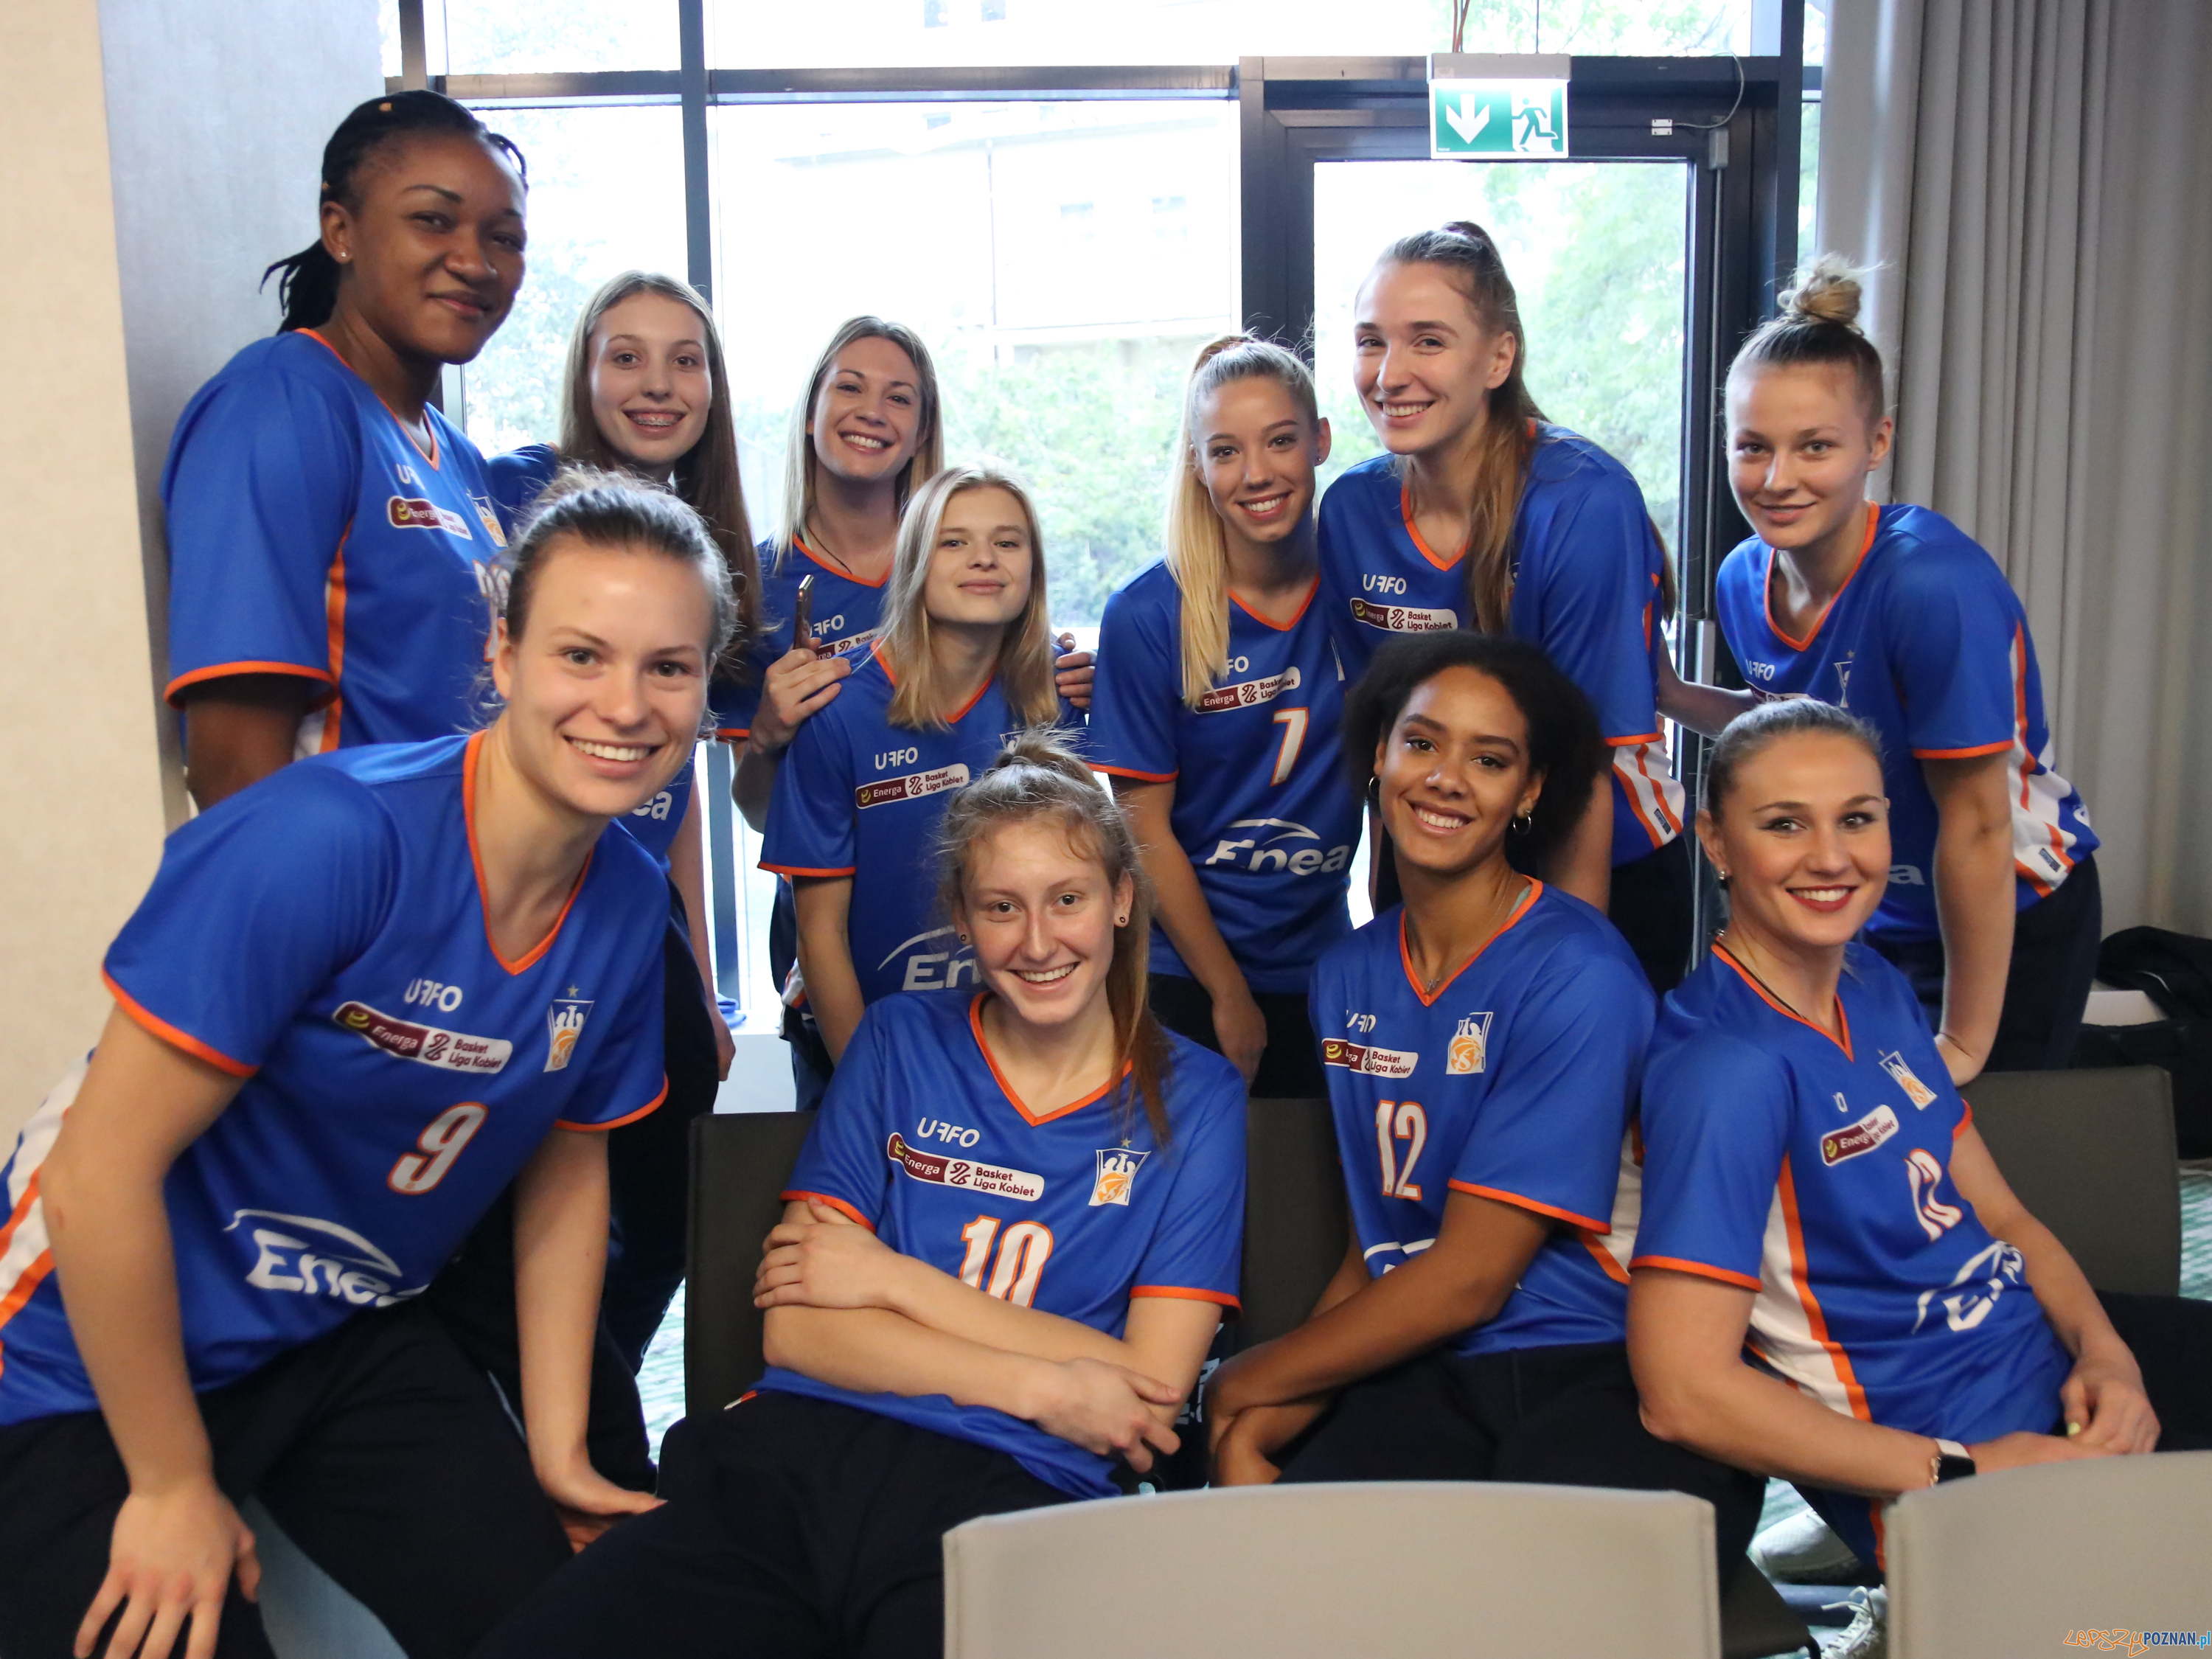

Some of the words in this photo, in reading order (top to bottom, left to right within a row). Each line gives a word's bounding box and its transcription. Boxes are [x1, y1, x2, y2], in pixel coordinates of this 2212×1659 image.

[1408, 611, 1432, 622] Basket
[1407, 621, 1423, 632] Liga
[1204, 694, 1234, 707] Energa
[1270, 707, 1309, 787] 7
[925, 771, 948, 782] Basket
[926, 781, 941, 792] Liga
[942, 776, 964, 787] Kobiet
[873, 785, 902, 798] Energa
[902, 952, 982, 991] En
[372, 1025, 419, 1051] Energa
[454, 1038, 489, 1054] Basket
[448, 1051, 470, 1068] Liga
[471, 1055, 502, 1069] Kobiet
[1372, 1051, 1401, 1063] Basket
[1370, 1062, 1388, 1073] Liga
[1389, 1065, 1411, 1074] Kobiet
[386, 1101, 490, 1195] 9
[1375, 1099, 1428, 1201] 12
[905, 1155, 941, 1175] Energa
[975, 1166, 1013, 1181] Basket
[973, 1178, 997, 1190] Liga
[998, 1182, 1035, 1197] Kobiet
[959, 1214, 1054, 1308] 10
